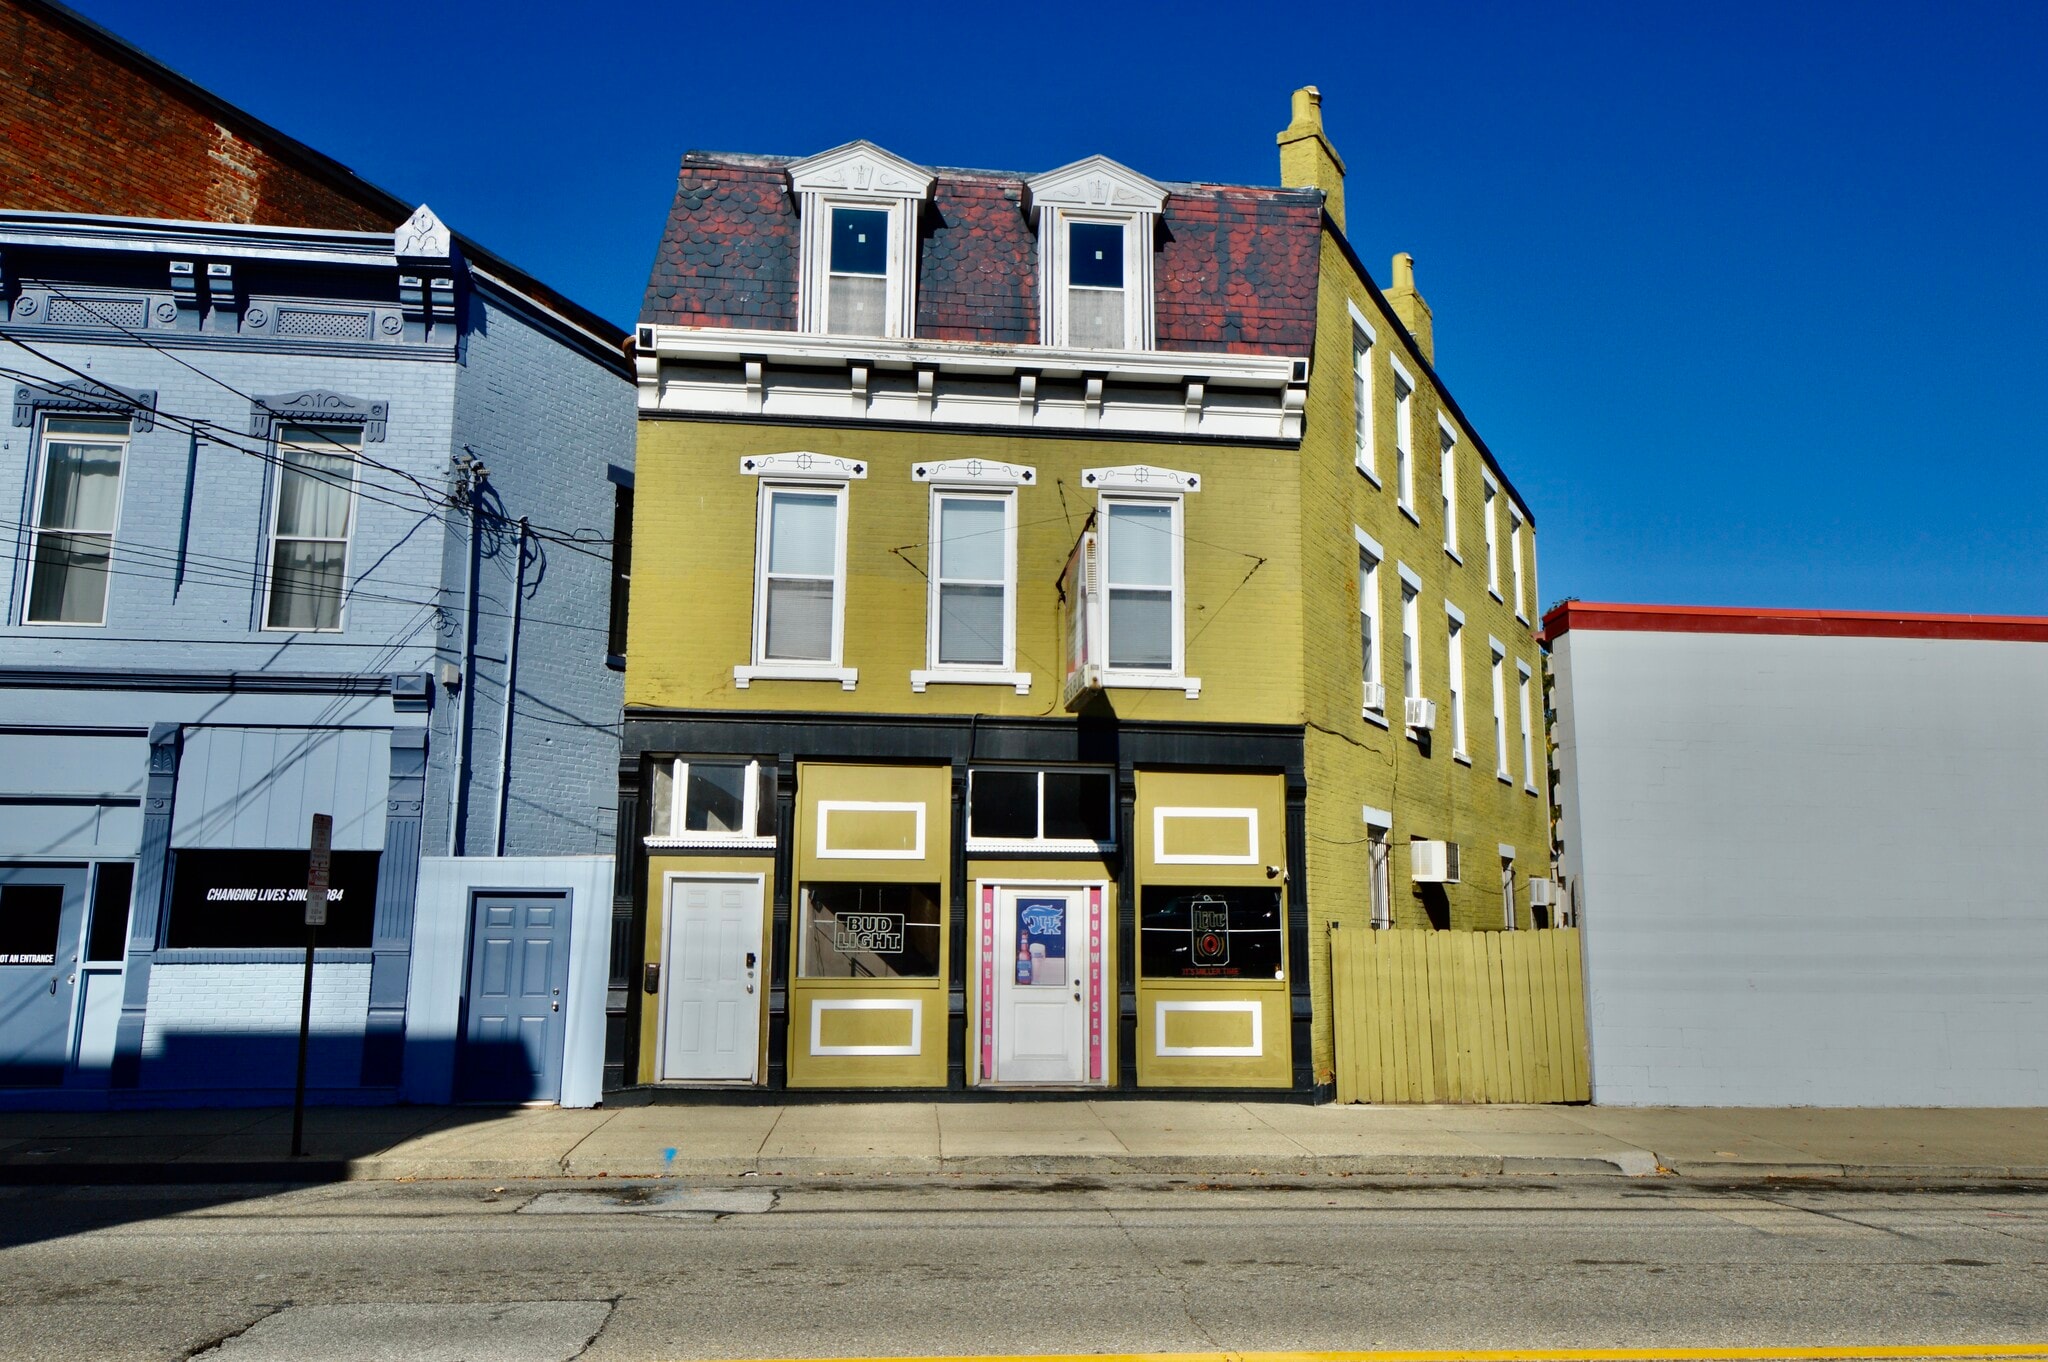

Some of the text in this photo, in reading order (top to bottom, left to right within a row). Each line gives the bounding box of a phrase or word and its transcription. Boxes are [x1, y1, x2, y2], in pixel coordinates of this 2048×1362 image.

[207, 888, 258, 901] CHANGING
[258, 889, 287, 901] LIVES
[287, 889, 308, 901] SINC
[847, 916, 892, 933] BUD
[1194, 911, 1226, 931] Lite
[0, 954, 54, 963] OT AN ENTRANCE
[983, 902, 993, 1046] BUDWEISER
[1091, 903, 1100, 1046] BUDWEISER
